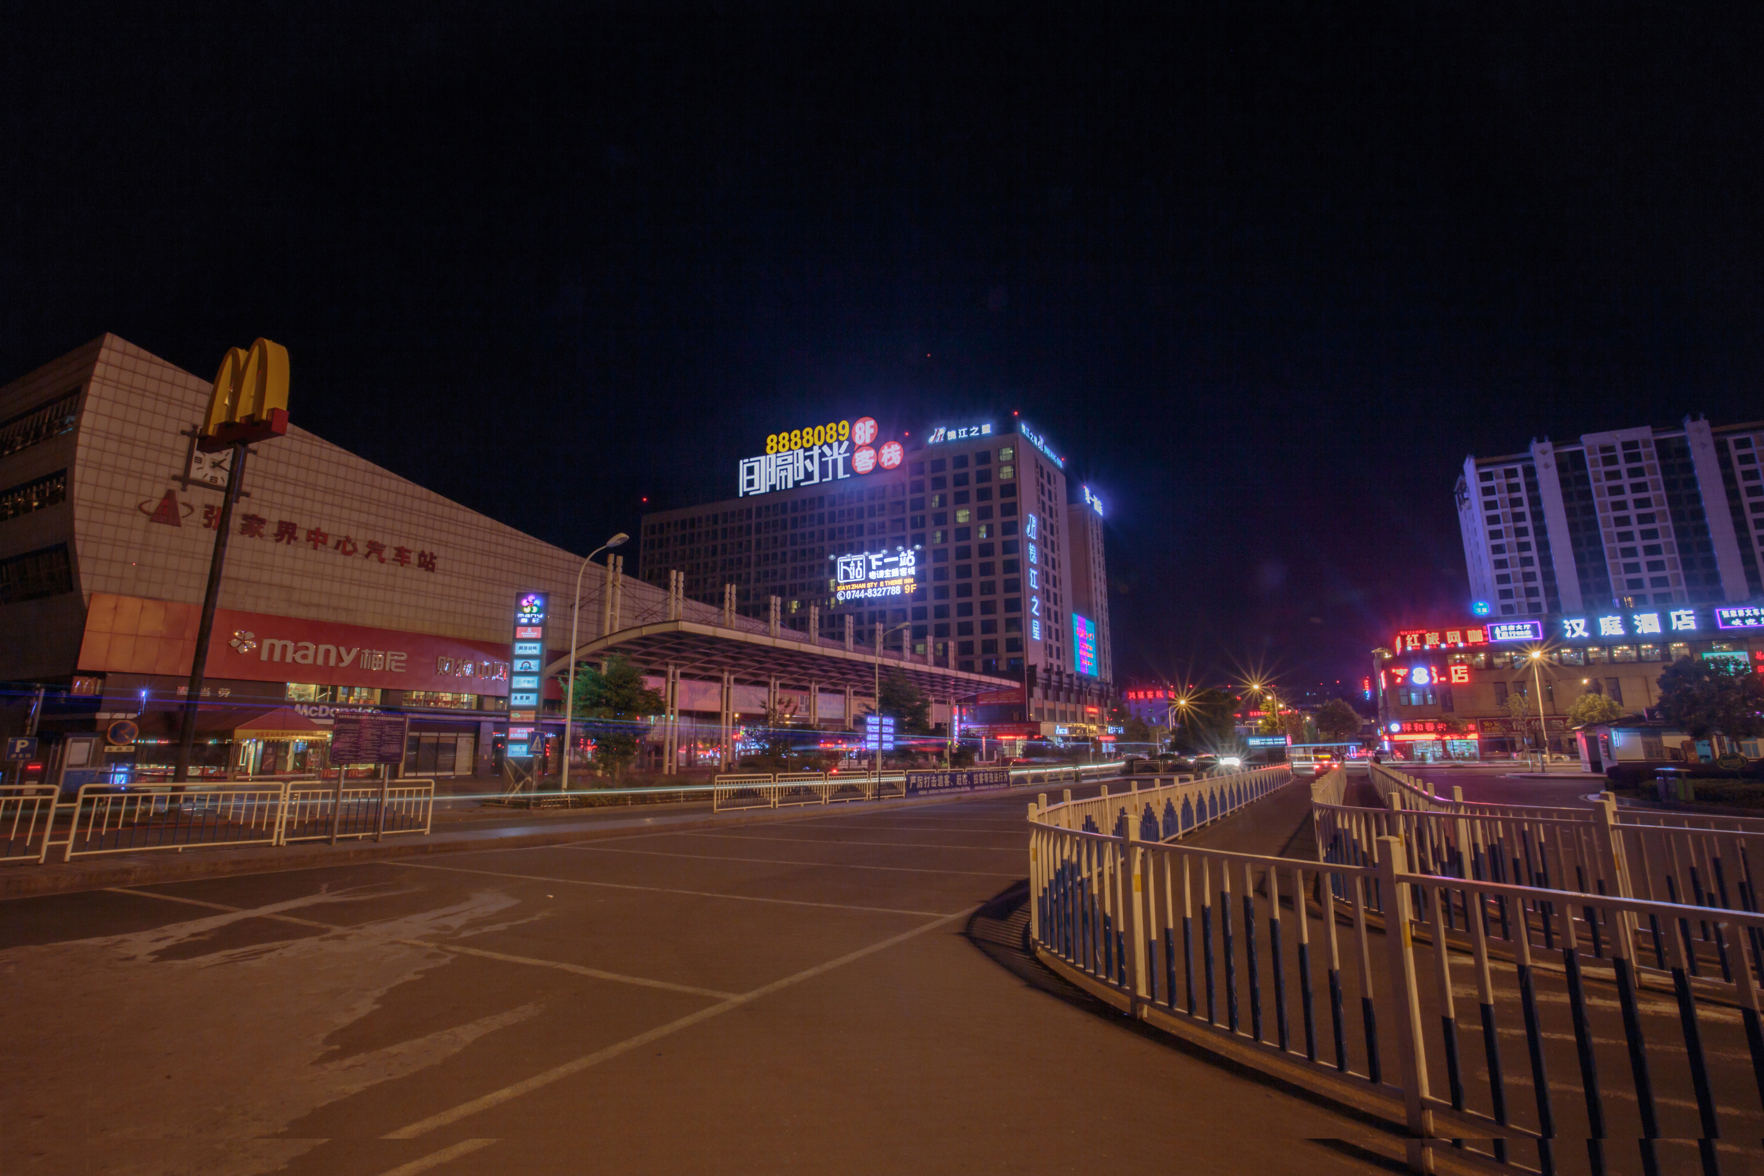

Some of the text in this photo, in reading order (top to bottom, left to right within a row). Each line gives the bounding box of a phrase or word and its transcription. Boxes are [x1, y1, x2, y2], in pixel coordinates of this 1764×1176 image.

[765, 419, 850, 455] 8888089
[854, 419, 876, 446] 8F
[738, 441, 852, 498] 间隔时光
[853, 444, 902, 472] 客栈
[203, 504, 438, 573] 张家界中心汽车站
[868, 549, 915, 570] 下一站
[846, 583, 917, 600] 0744-8327788 9F
[1405, 629, 1484, 647] 红旅网咖
[1563, 610, 1697, 638] 汉庭酒店
[260, 638, 360, 668] many
[360, 648, 408, 673] 梅尼
[15, 739, 29, 753] P
